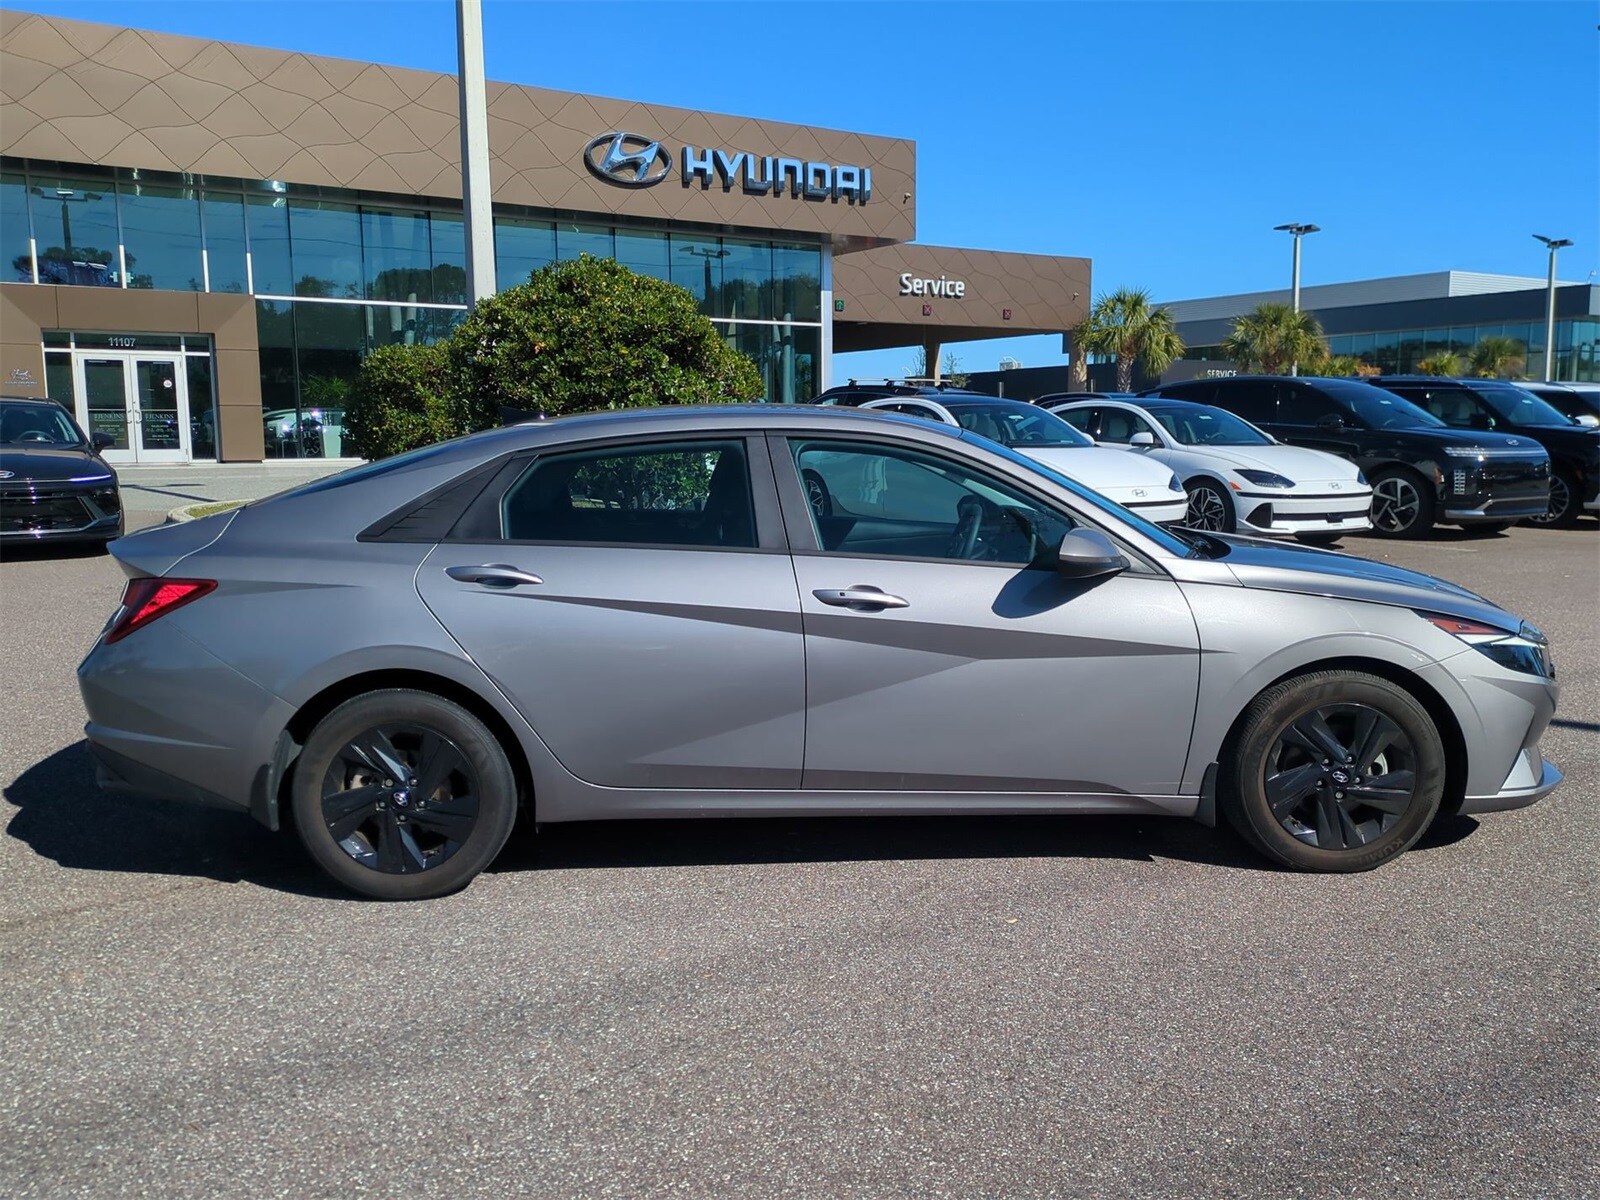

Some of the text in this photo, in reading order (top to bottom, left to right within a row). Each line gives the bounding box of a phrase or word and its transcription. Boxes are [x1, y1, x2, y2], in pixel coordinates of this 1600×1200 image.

[682, 145, 871, 204] HYUNDAI
[900, 273, 965, 297] Service
[108, 337, 136, 347] 11107
[1207, 369, 1237, 378] SERVICE
